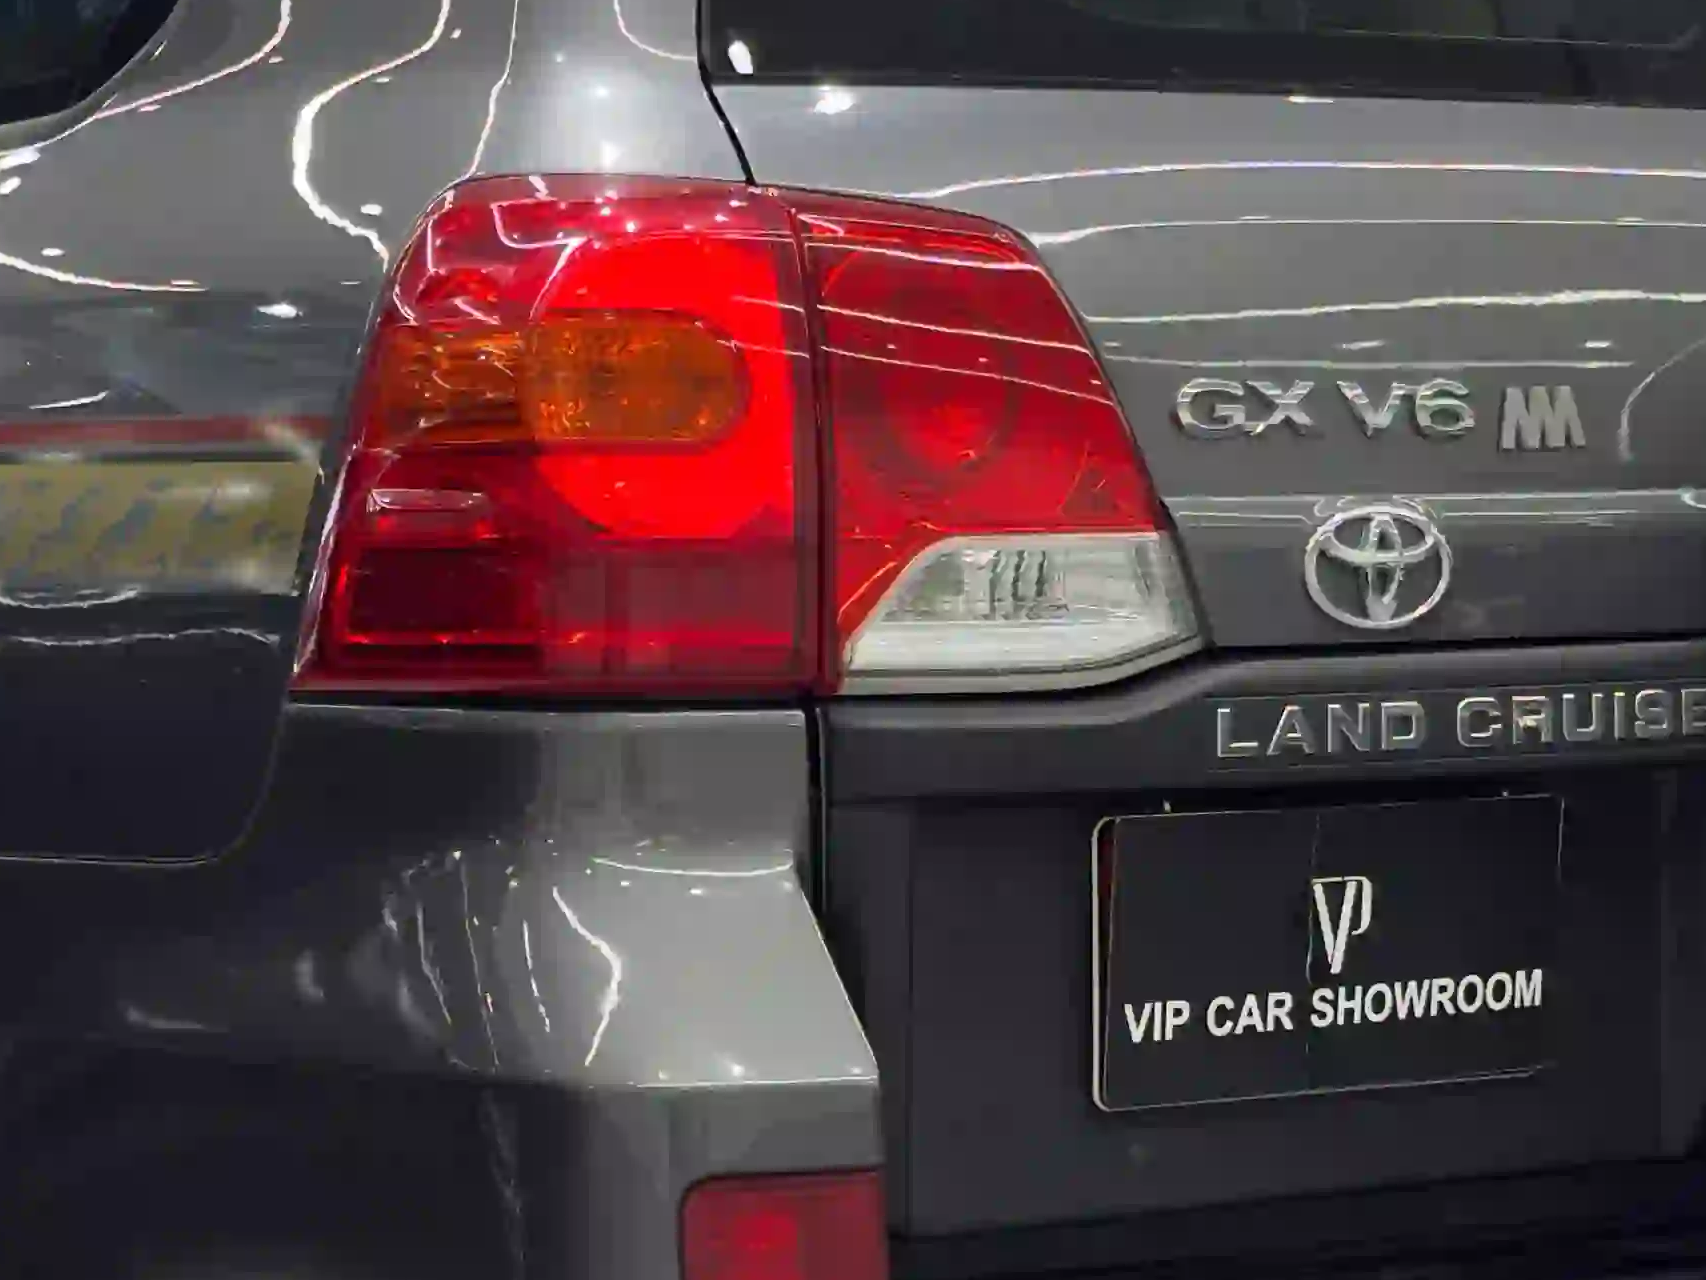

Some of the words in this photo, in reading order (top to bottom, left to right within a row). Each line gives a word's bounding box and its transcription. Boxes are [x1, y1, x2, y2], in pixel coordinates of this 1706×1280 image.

[1177, 377, 1316, 439] GX
[1336, 377, 1477, 438] V6
[1215, 699, 1427, 758] LAND
[1124, 999, 1191, 1044] VIP
[1206, 991, 1294, 1037] CAR
[1310, 968, 1543, 1028] SHOWROOM
